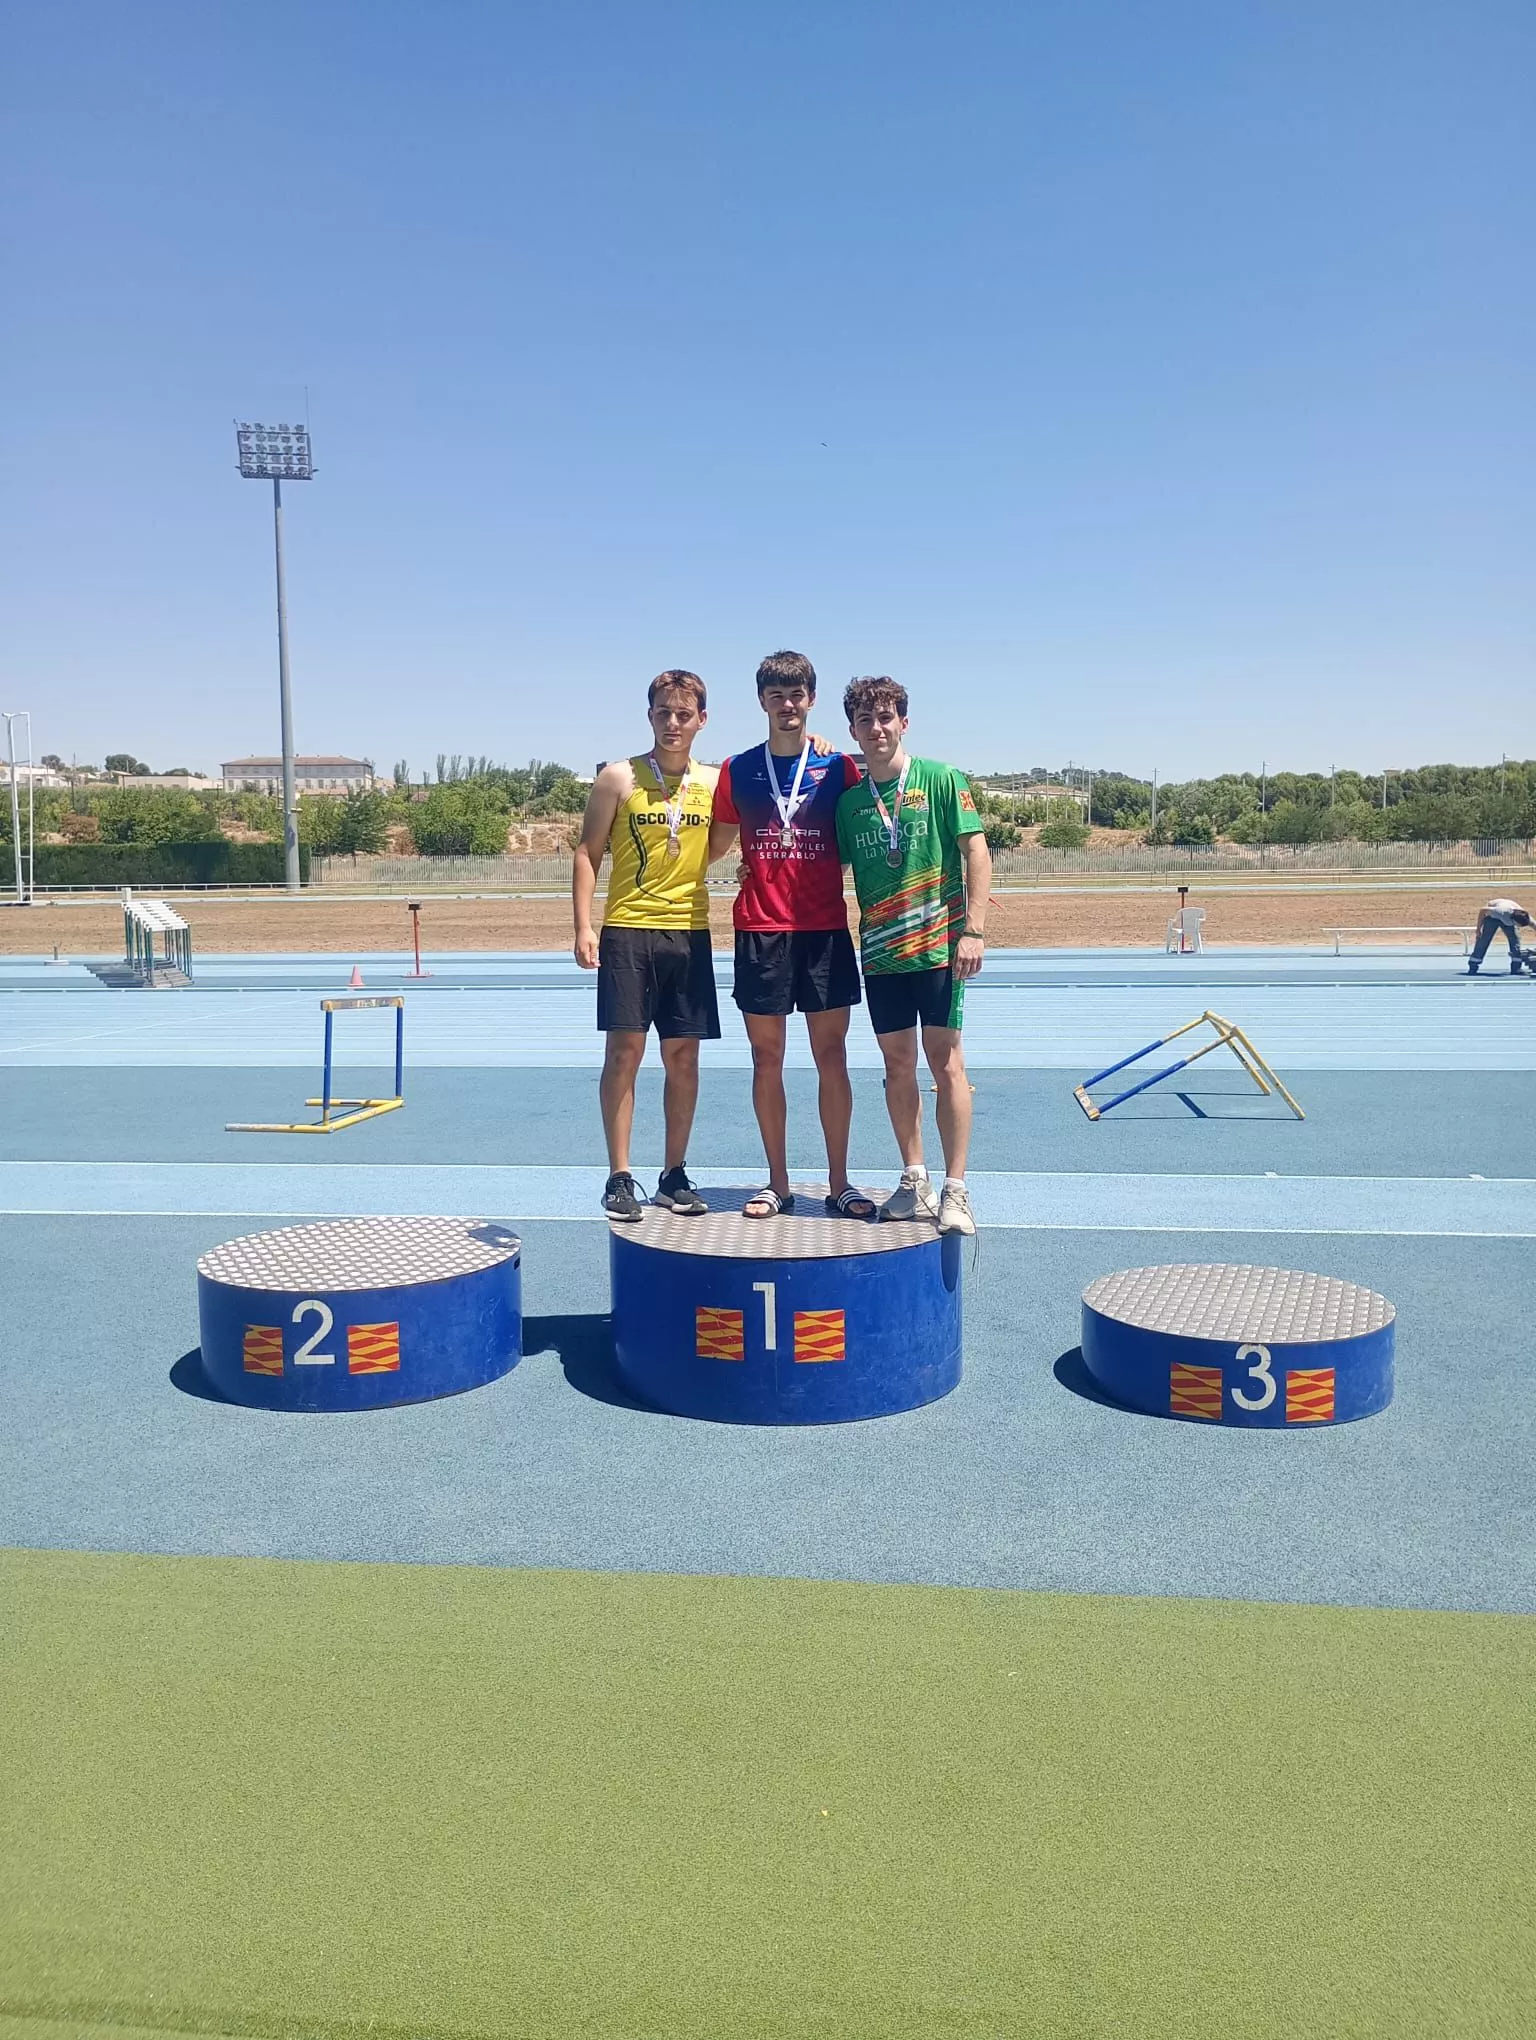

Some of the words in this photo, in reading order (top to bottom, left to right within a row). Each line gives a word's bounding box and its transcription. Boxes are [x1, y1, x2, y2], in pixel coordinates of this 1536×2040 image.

[750, 841, 825, 851] AUTOOVILES
[756, 828, 821, 837] CURA
[759, 851, 816, 860] SERRABLO
[292, 1299, 335, 1365] 2
[753, 1282, 776, 1350] 1
[1231, 1343, 1276, 1411] 3
